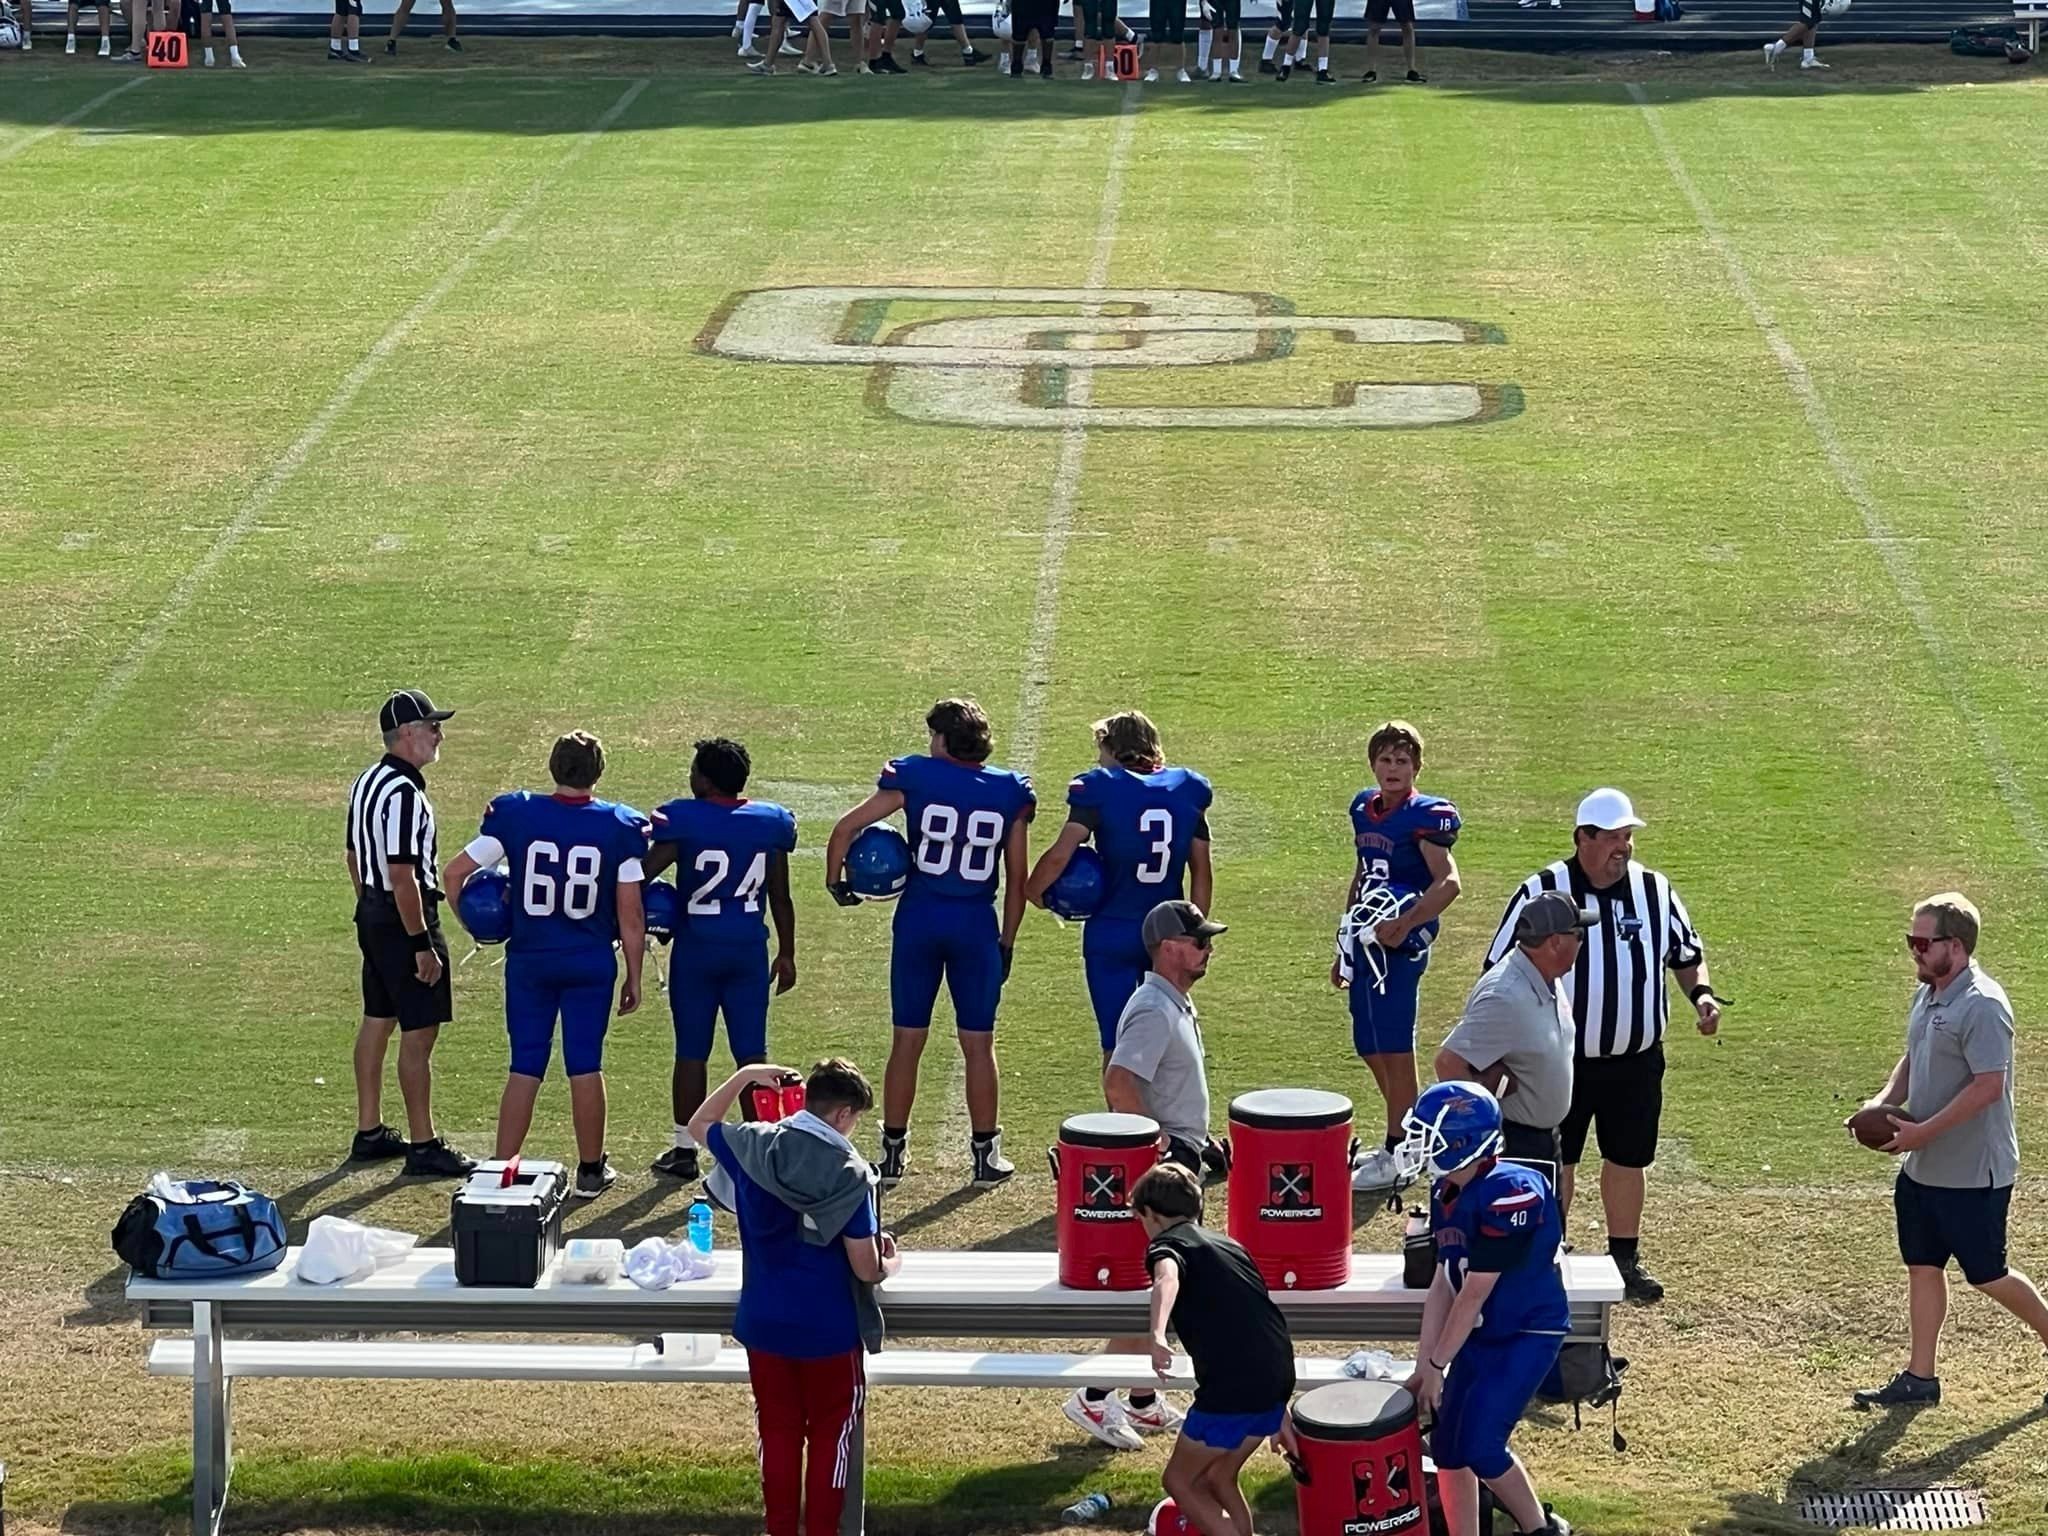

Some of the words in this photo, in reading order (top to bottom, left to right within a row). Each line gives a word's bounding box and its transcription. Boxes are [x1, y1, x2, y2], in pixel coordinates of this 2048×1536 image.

[151, 36, 181, 62] 40
[692, 284, 1525, 429] OC
[916, 803, 1004, 881] 88
[1136, 808, 1173, 883] 3
[1440, 817, 1452, 831] 18
[524, 840, 601, 920] 68
[687, 849, 768, 915] 24
[1260, 1208, 1322, 1218] POWERADE
[1510, 1210, 1527, 1226] 40
[1344, 1505, 1420, 1534] POWERADE
